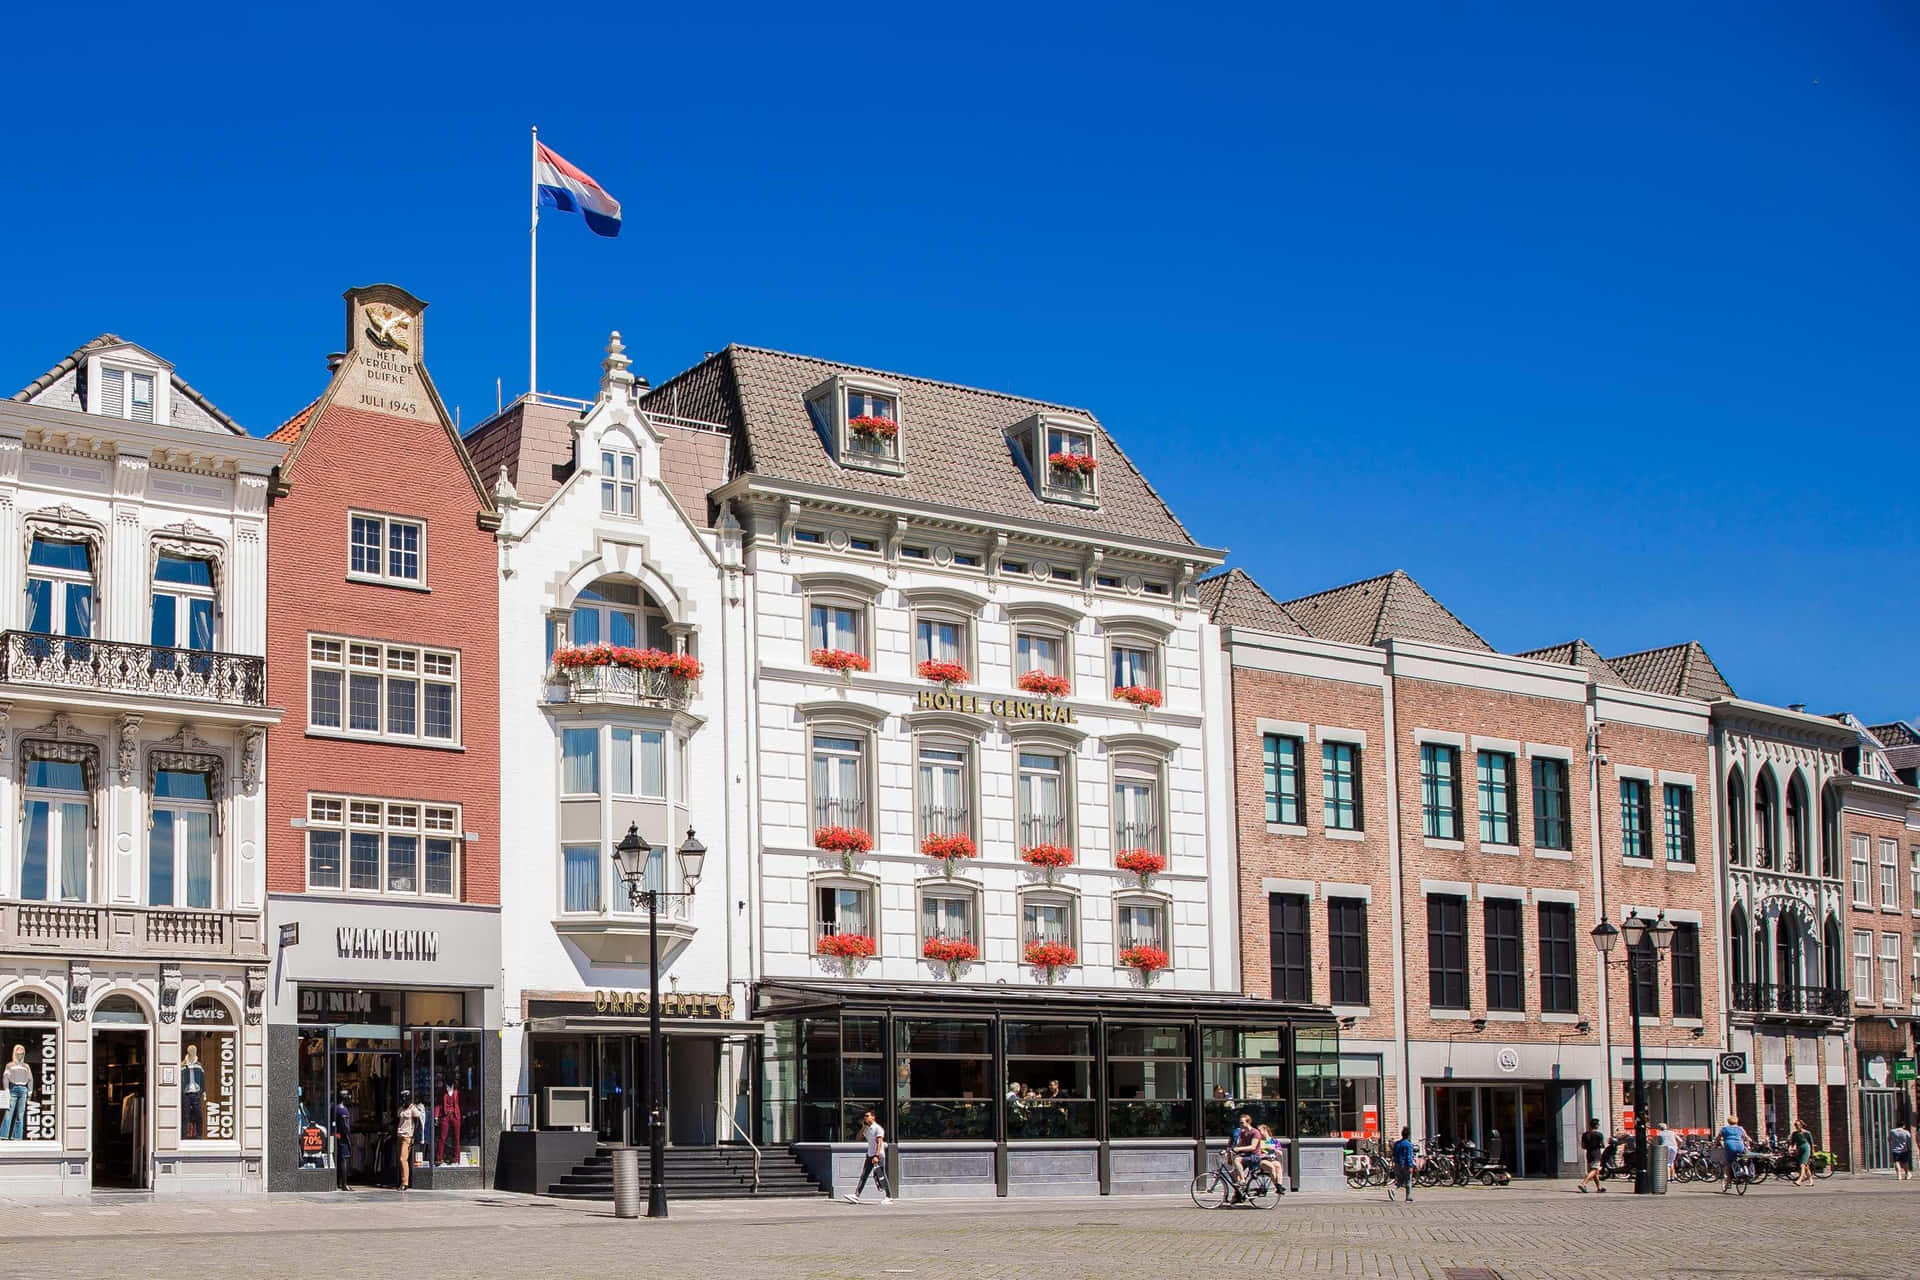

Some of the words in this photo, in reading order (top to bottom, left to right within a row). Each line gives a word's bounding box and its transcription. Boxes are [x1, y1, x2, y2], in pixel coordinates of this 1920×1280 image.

[359, 357, 414, 375] VERGULDE
[377, 351, 396, 361] HET
[367, 370, 405, 384] DUIFKE
[359, 394, 384, 408] JULI
[390, 400, 417, 414] 1945
[918, 690, 984, 714] HOTEL
[990, 699, 1078, 724] CENTRAL
[594, 990, 712, 1016] BRASERIE
[41, 1033, 56, 1139] COLLECTION
[220, 1037, 234, 1139] COLLECTION
[27, 1100, 41, 1139] NEW
[206, 1101, 221, 1138] NEW
